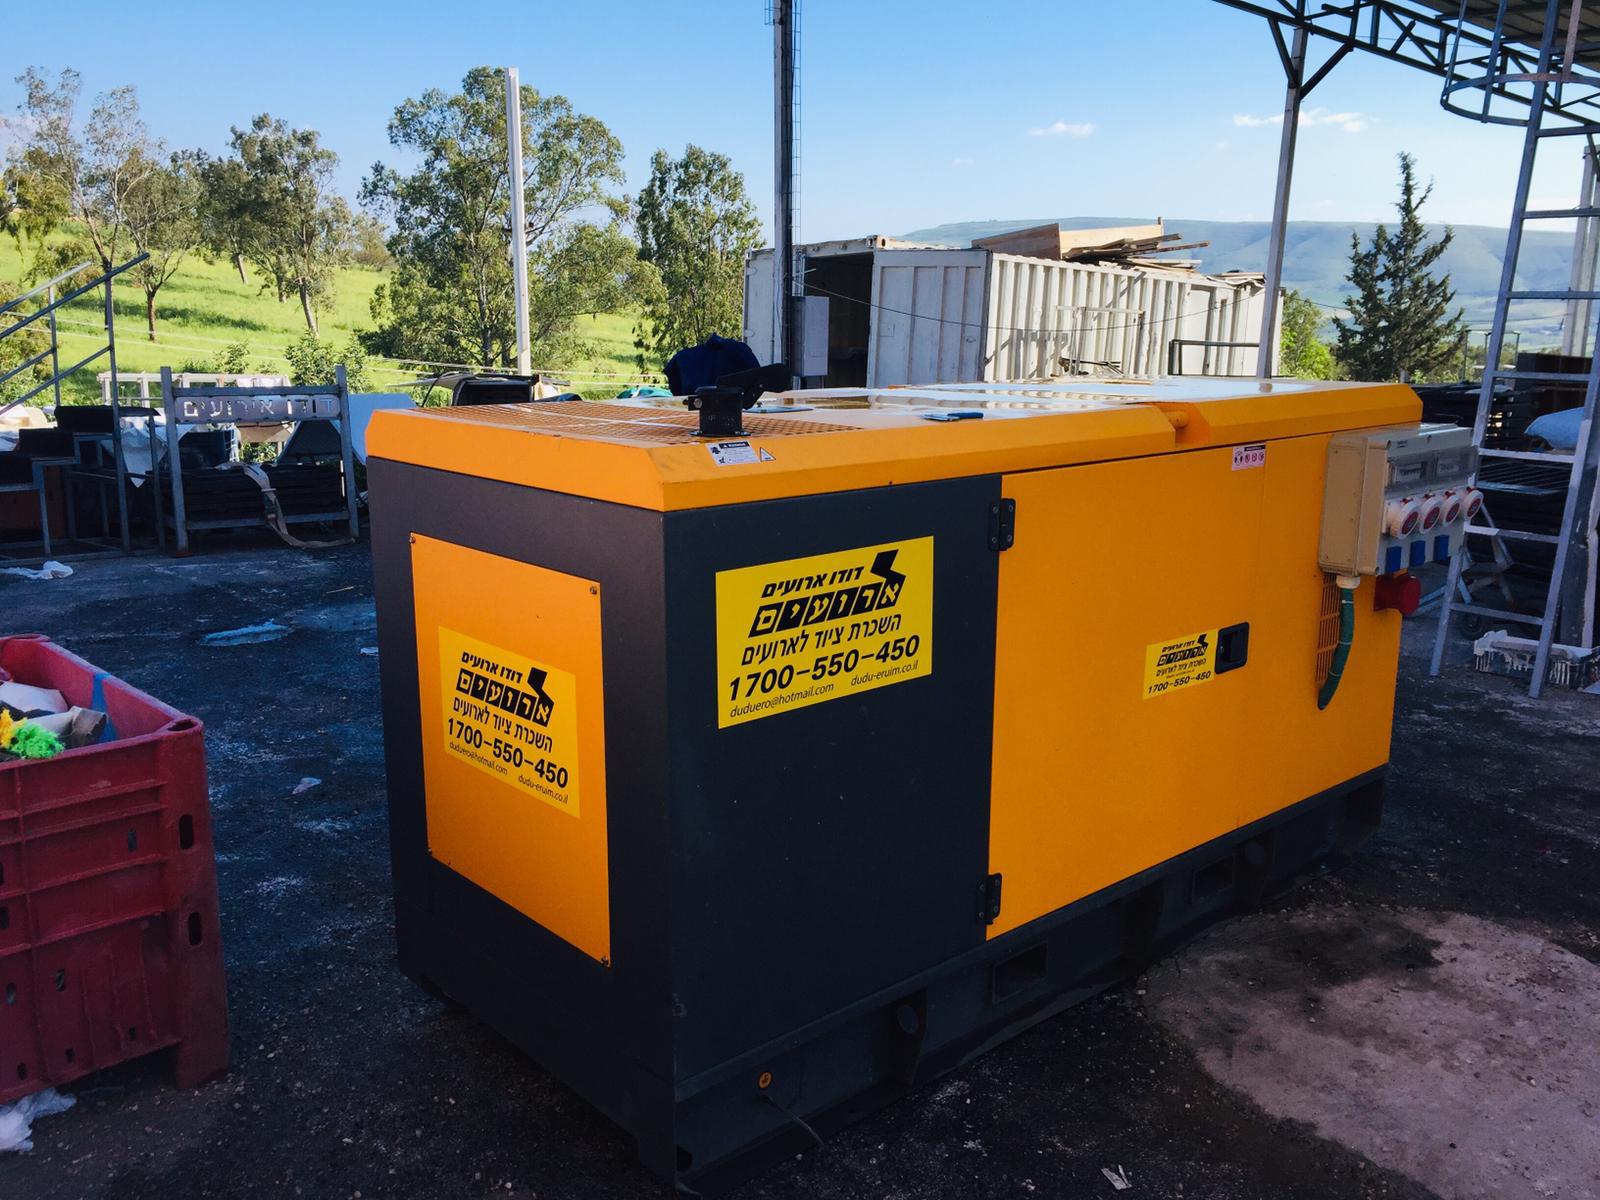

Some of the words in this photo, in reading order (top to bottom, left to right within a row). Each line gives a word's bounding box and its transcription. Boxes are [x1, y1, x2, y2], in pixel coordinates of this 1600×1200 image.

[287, 399, 333, 415] דודו
[761, 571, 829, 598] ארועים
[828, 566, 865, 586] דודו
[748, 575, 906, 638] ארועים
[815, 624, 845, 650] ציוד
[847, 614, 902, 642] השכרת
[741, 628, 809, 666] לארועים
[461, 651, 499, 675] ארועים
[500, 667, 523, 684] דודו
[729, 635, 920, 701] 1700-550-450
[729, 683, 834, 718] duduero@hotmail.com
[850, 660, 919, 687] dudu-eruim.co.il
[1148, 670, 1212, 694] 1700-550-450
[453, 697, 490, 725] לארועים
[456, 667, 554, 727] ארועים
[493, 713, 512, 735] ציוד
[514, 724, 553, 753] השכרת
[448, 718, 569, 788] 1700-550-450
[518, 774, 569, 804] dudu-eruim.co.il
